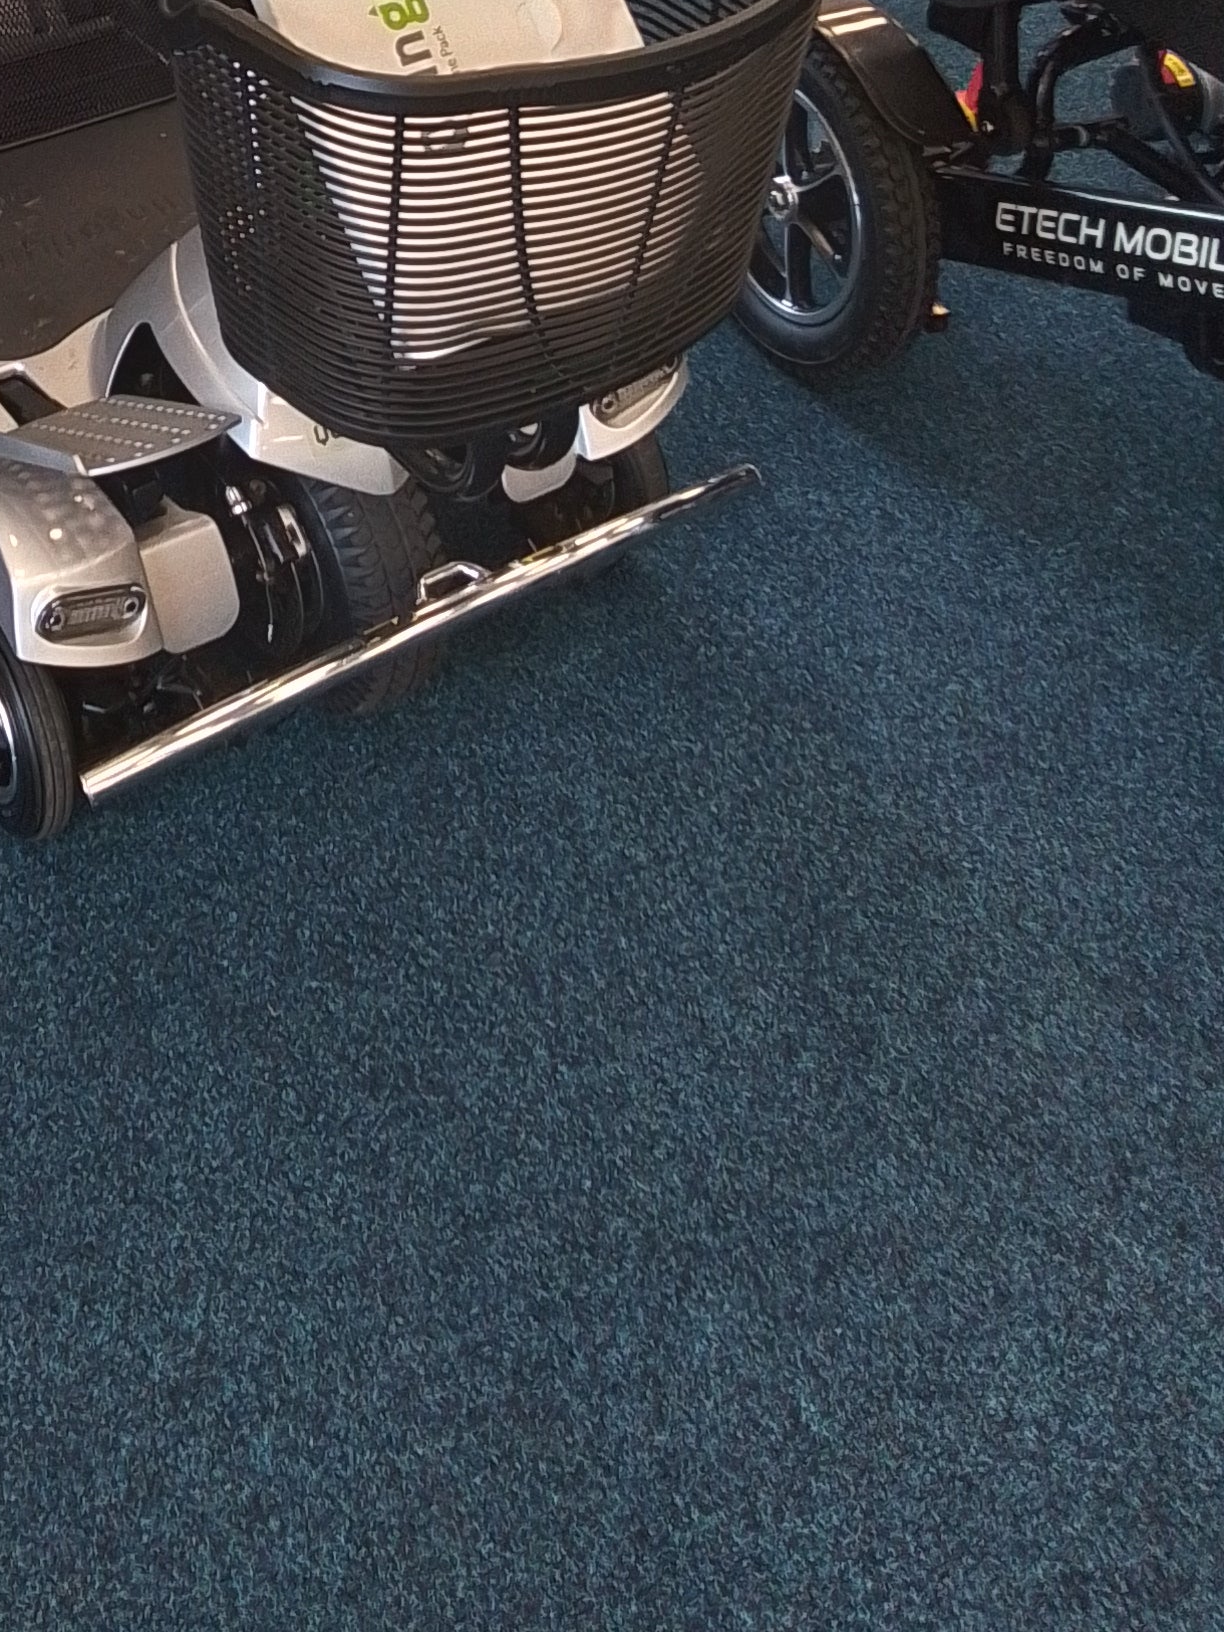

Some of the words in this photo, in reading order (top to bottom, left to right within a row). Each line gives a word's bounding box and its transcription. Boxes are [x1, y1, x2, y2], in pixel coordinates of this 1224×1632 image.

[433, 24, 456, 61] Pack
[995, 201, 1105, 249] ETECH
[1113, 221, 1224, 273] MOBIL
[1003, 241, 1104, 274] FREEDOM
[1116, 262, 1146, 282] OF
[1158, 272, 1224, 300] MOVE
